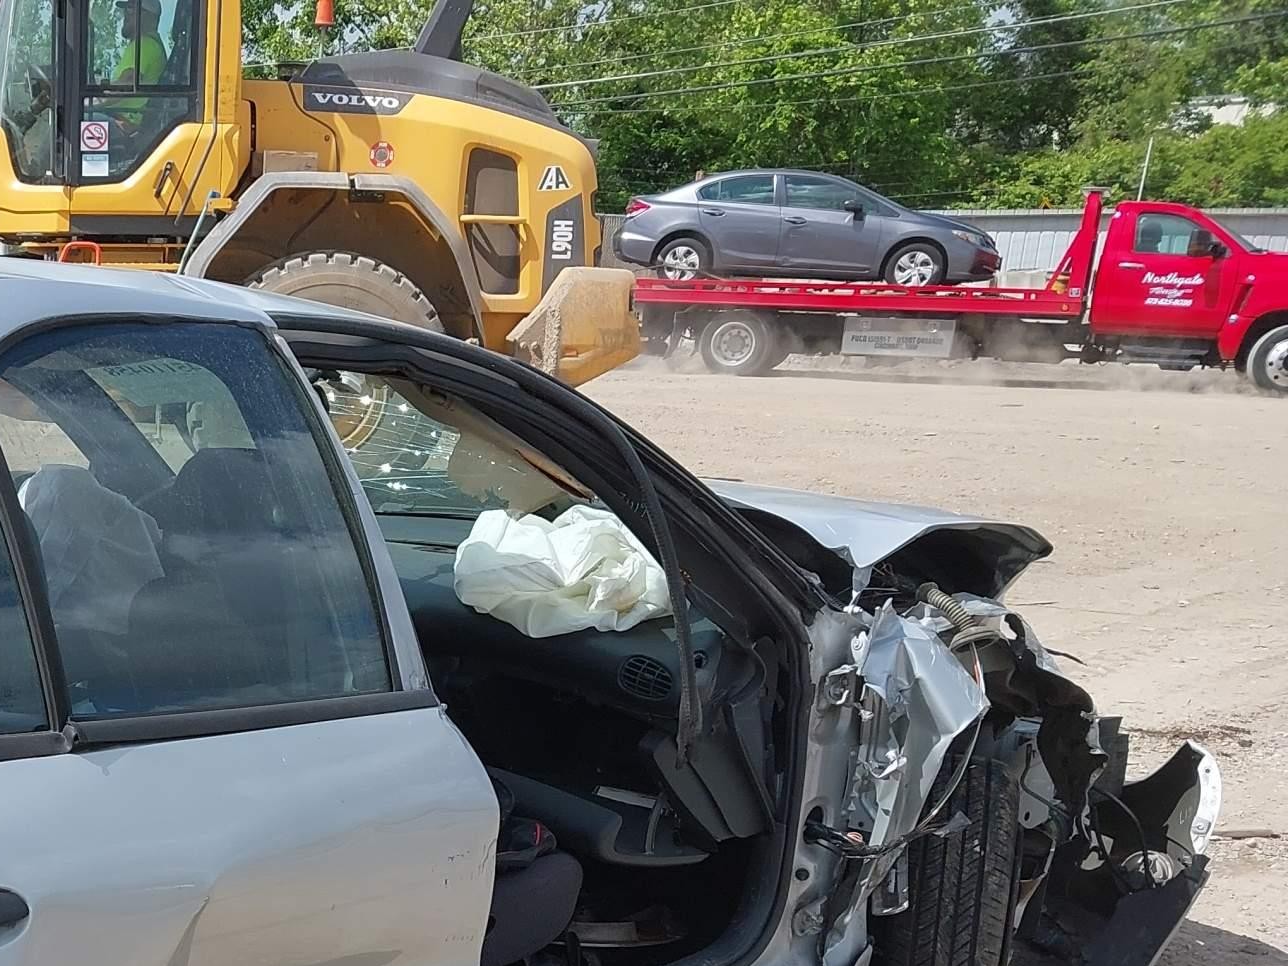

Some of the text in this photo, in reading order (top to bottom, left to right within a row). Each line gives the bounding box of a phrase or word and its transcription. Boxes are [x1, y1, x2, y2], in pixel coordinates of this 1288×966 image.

[312, 93, 400, 109] VOLVO
[552, 220, 574, 260] L90H
[1141, 272, 1205, 288] Northgate
